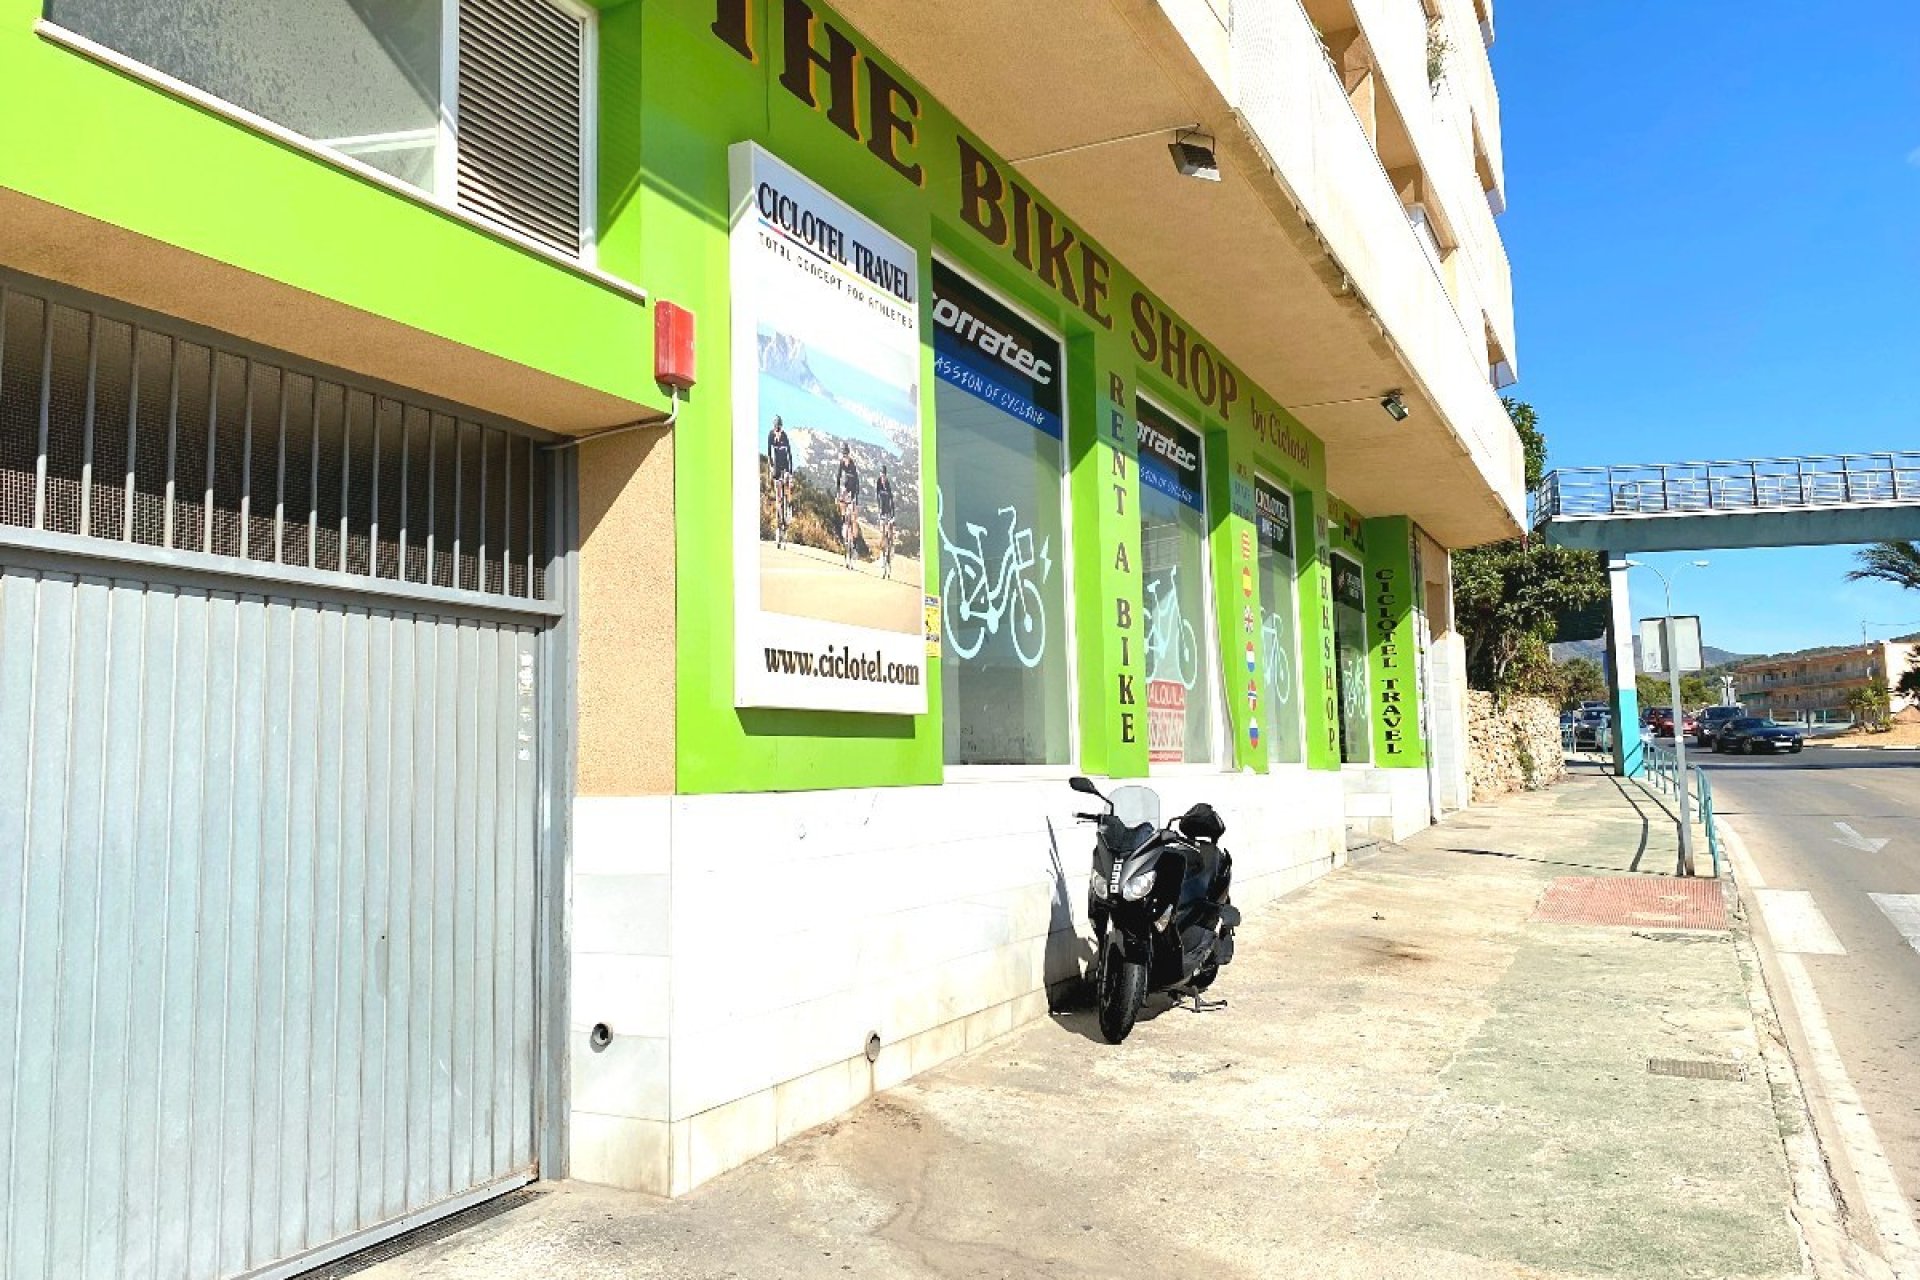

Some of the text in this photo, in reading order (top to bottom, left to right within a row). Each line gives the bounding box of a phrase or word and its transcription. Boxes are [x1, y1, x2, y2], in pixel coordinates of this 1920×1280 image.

[758, 182, 913, 304] CICLOTEL TRAVEL
[758, 231, 914, 329] TOTAL CONCEPT FOR ATHLETES
[956, 135, 1113, 331] BIKE
[1130, 292, 1238, 421] SHOP
[1250, 396, 1266, 443] by
[932, 290, 1052, 386] orratec
[934, 355, 983, 394] ASSION
[984, 383, 1000, 401] OF
[1136, 419, 1197, 472] orratec
[1109, 371, 1136, 743] RENT A BIKE
[763, 644, 921, 686] www.ciclotel.com
[1375, 568, 1403, 755] CICLOTEL TRAVEL
